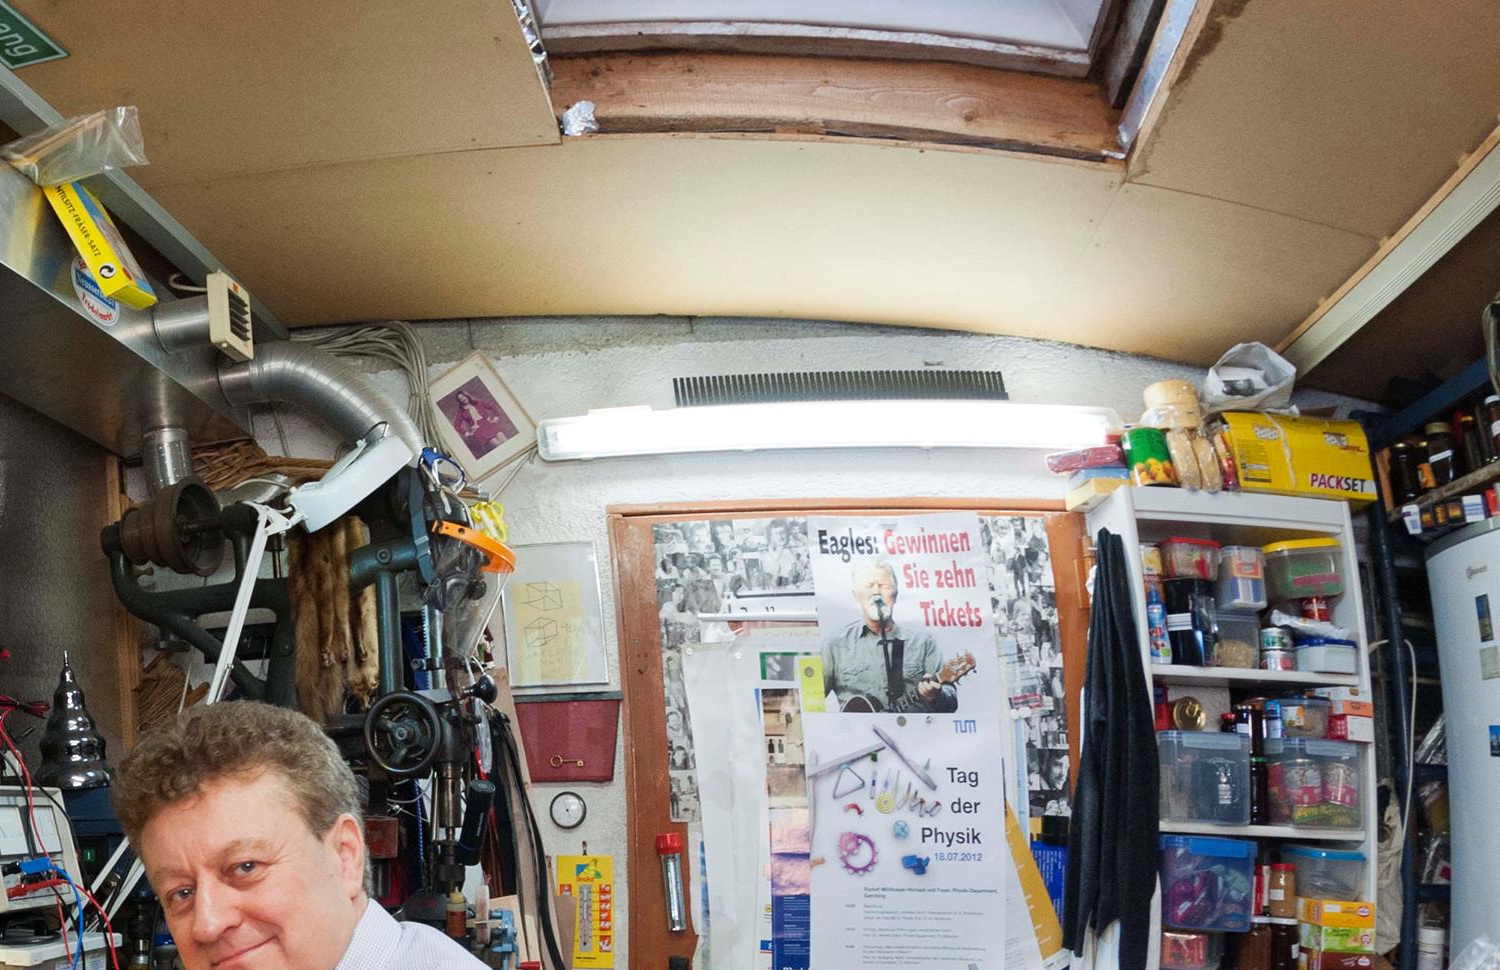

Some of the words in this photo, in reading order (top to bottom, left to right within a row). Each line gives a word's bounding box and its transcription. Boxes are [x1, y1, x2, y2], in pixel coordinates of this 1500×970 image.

[1309, 472, 1367, 493] PACKSET
[818, 528, 879, 563] Eagles:
[884, 527, 971, 556] Gewinnen
[903, 562, 929, 589] Sie
[934, 560, 976, 588] zehn
[919, 600, 983, 628] Tickets
[946, 767, 979, 787] Tag
[950, 798, 980, 814] der
[921, 827, 982, 848] Physik
[934, 852, 983, 862] 18.07.2012
